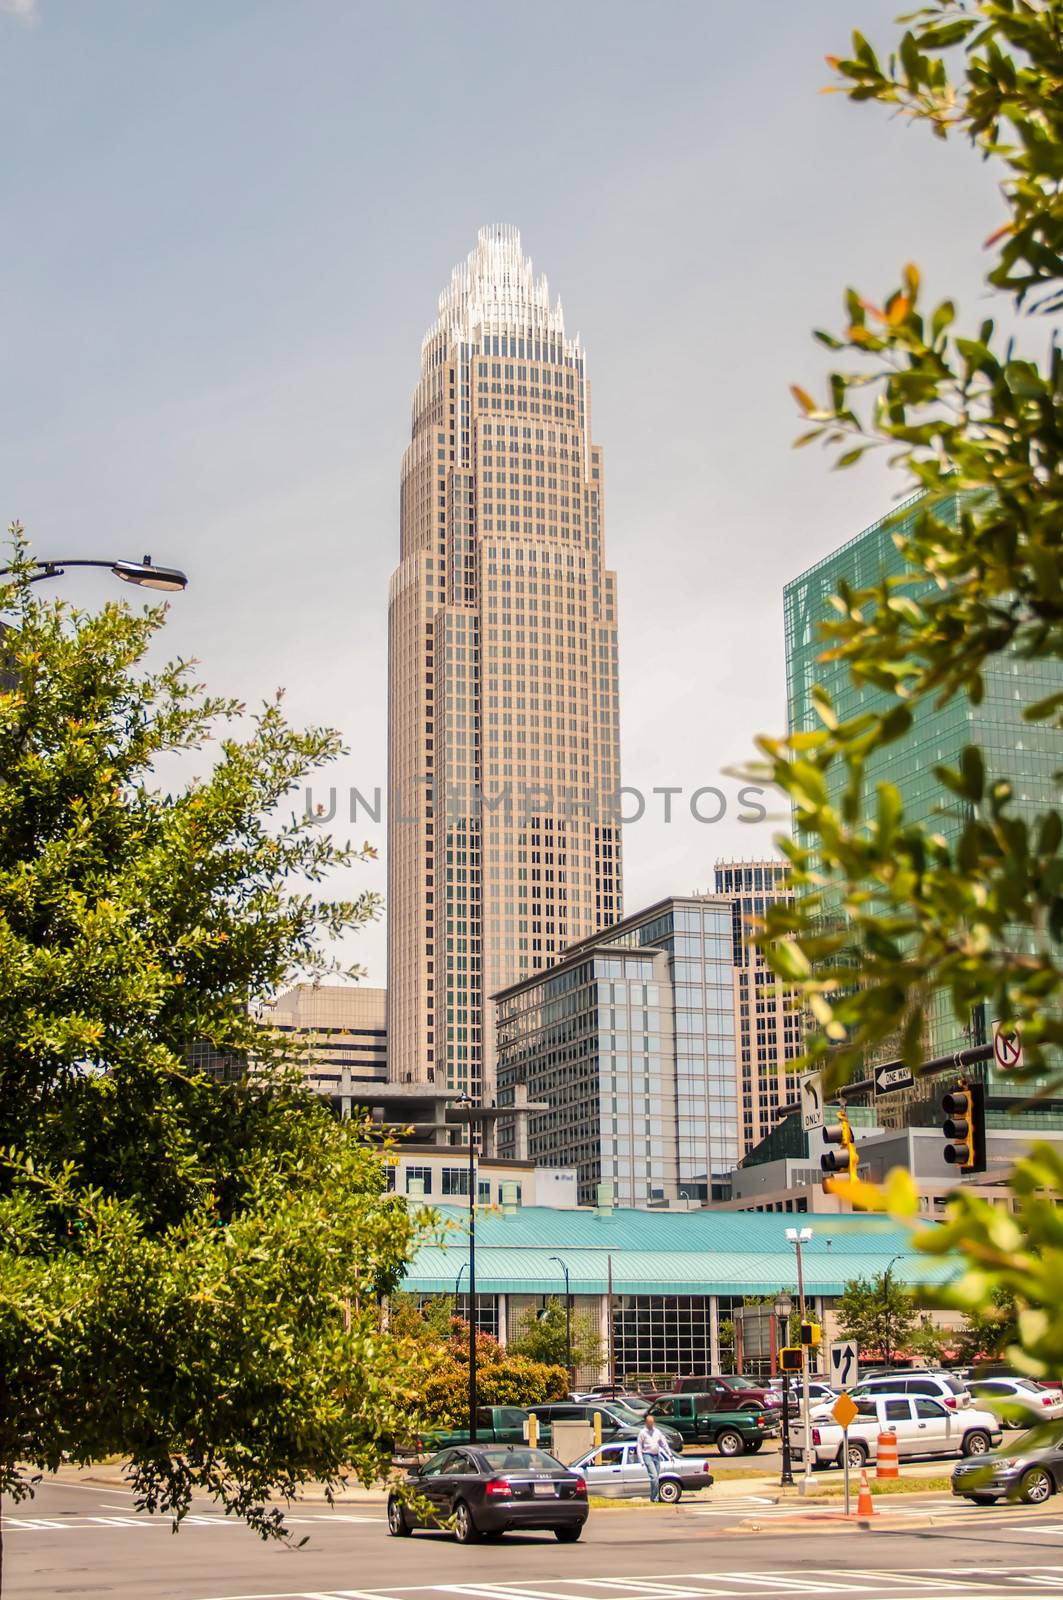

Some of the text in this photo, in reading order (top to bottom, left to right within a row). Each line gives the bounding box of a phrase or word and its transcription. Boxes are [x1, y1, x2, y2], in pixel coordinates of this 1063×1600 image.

[885, 1068, 910, 1084] ONE WAY
[805, 1112, 821, 1127] ONLY
